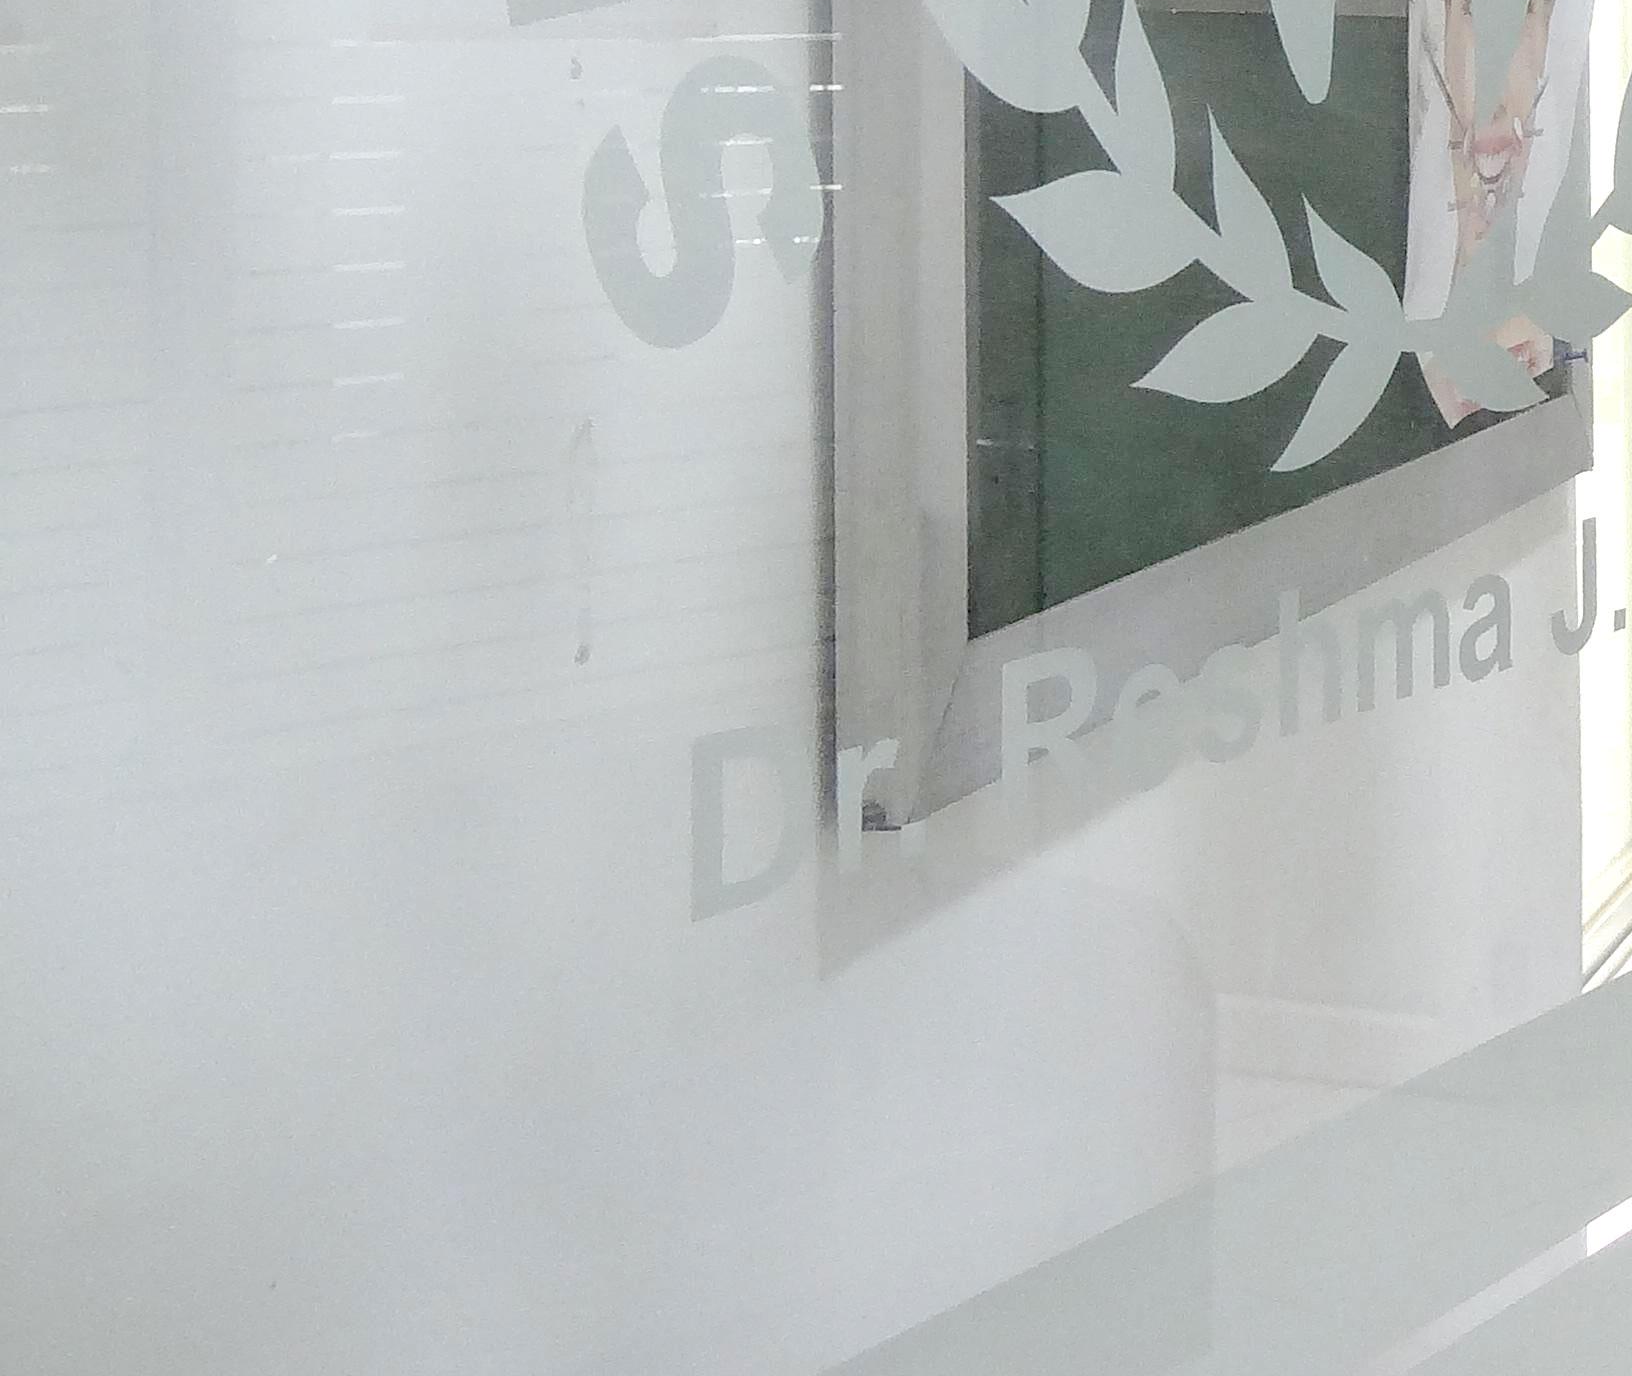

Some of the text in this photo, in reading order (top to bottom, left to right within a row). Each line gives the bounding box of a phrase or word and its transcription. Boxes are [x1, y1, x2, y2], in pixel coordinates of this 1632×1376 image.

[691, 722, 926, 923] Dr.
[1001, 571, 1515, 824] Reshma
[1550, 516, 1627, 656] J.
